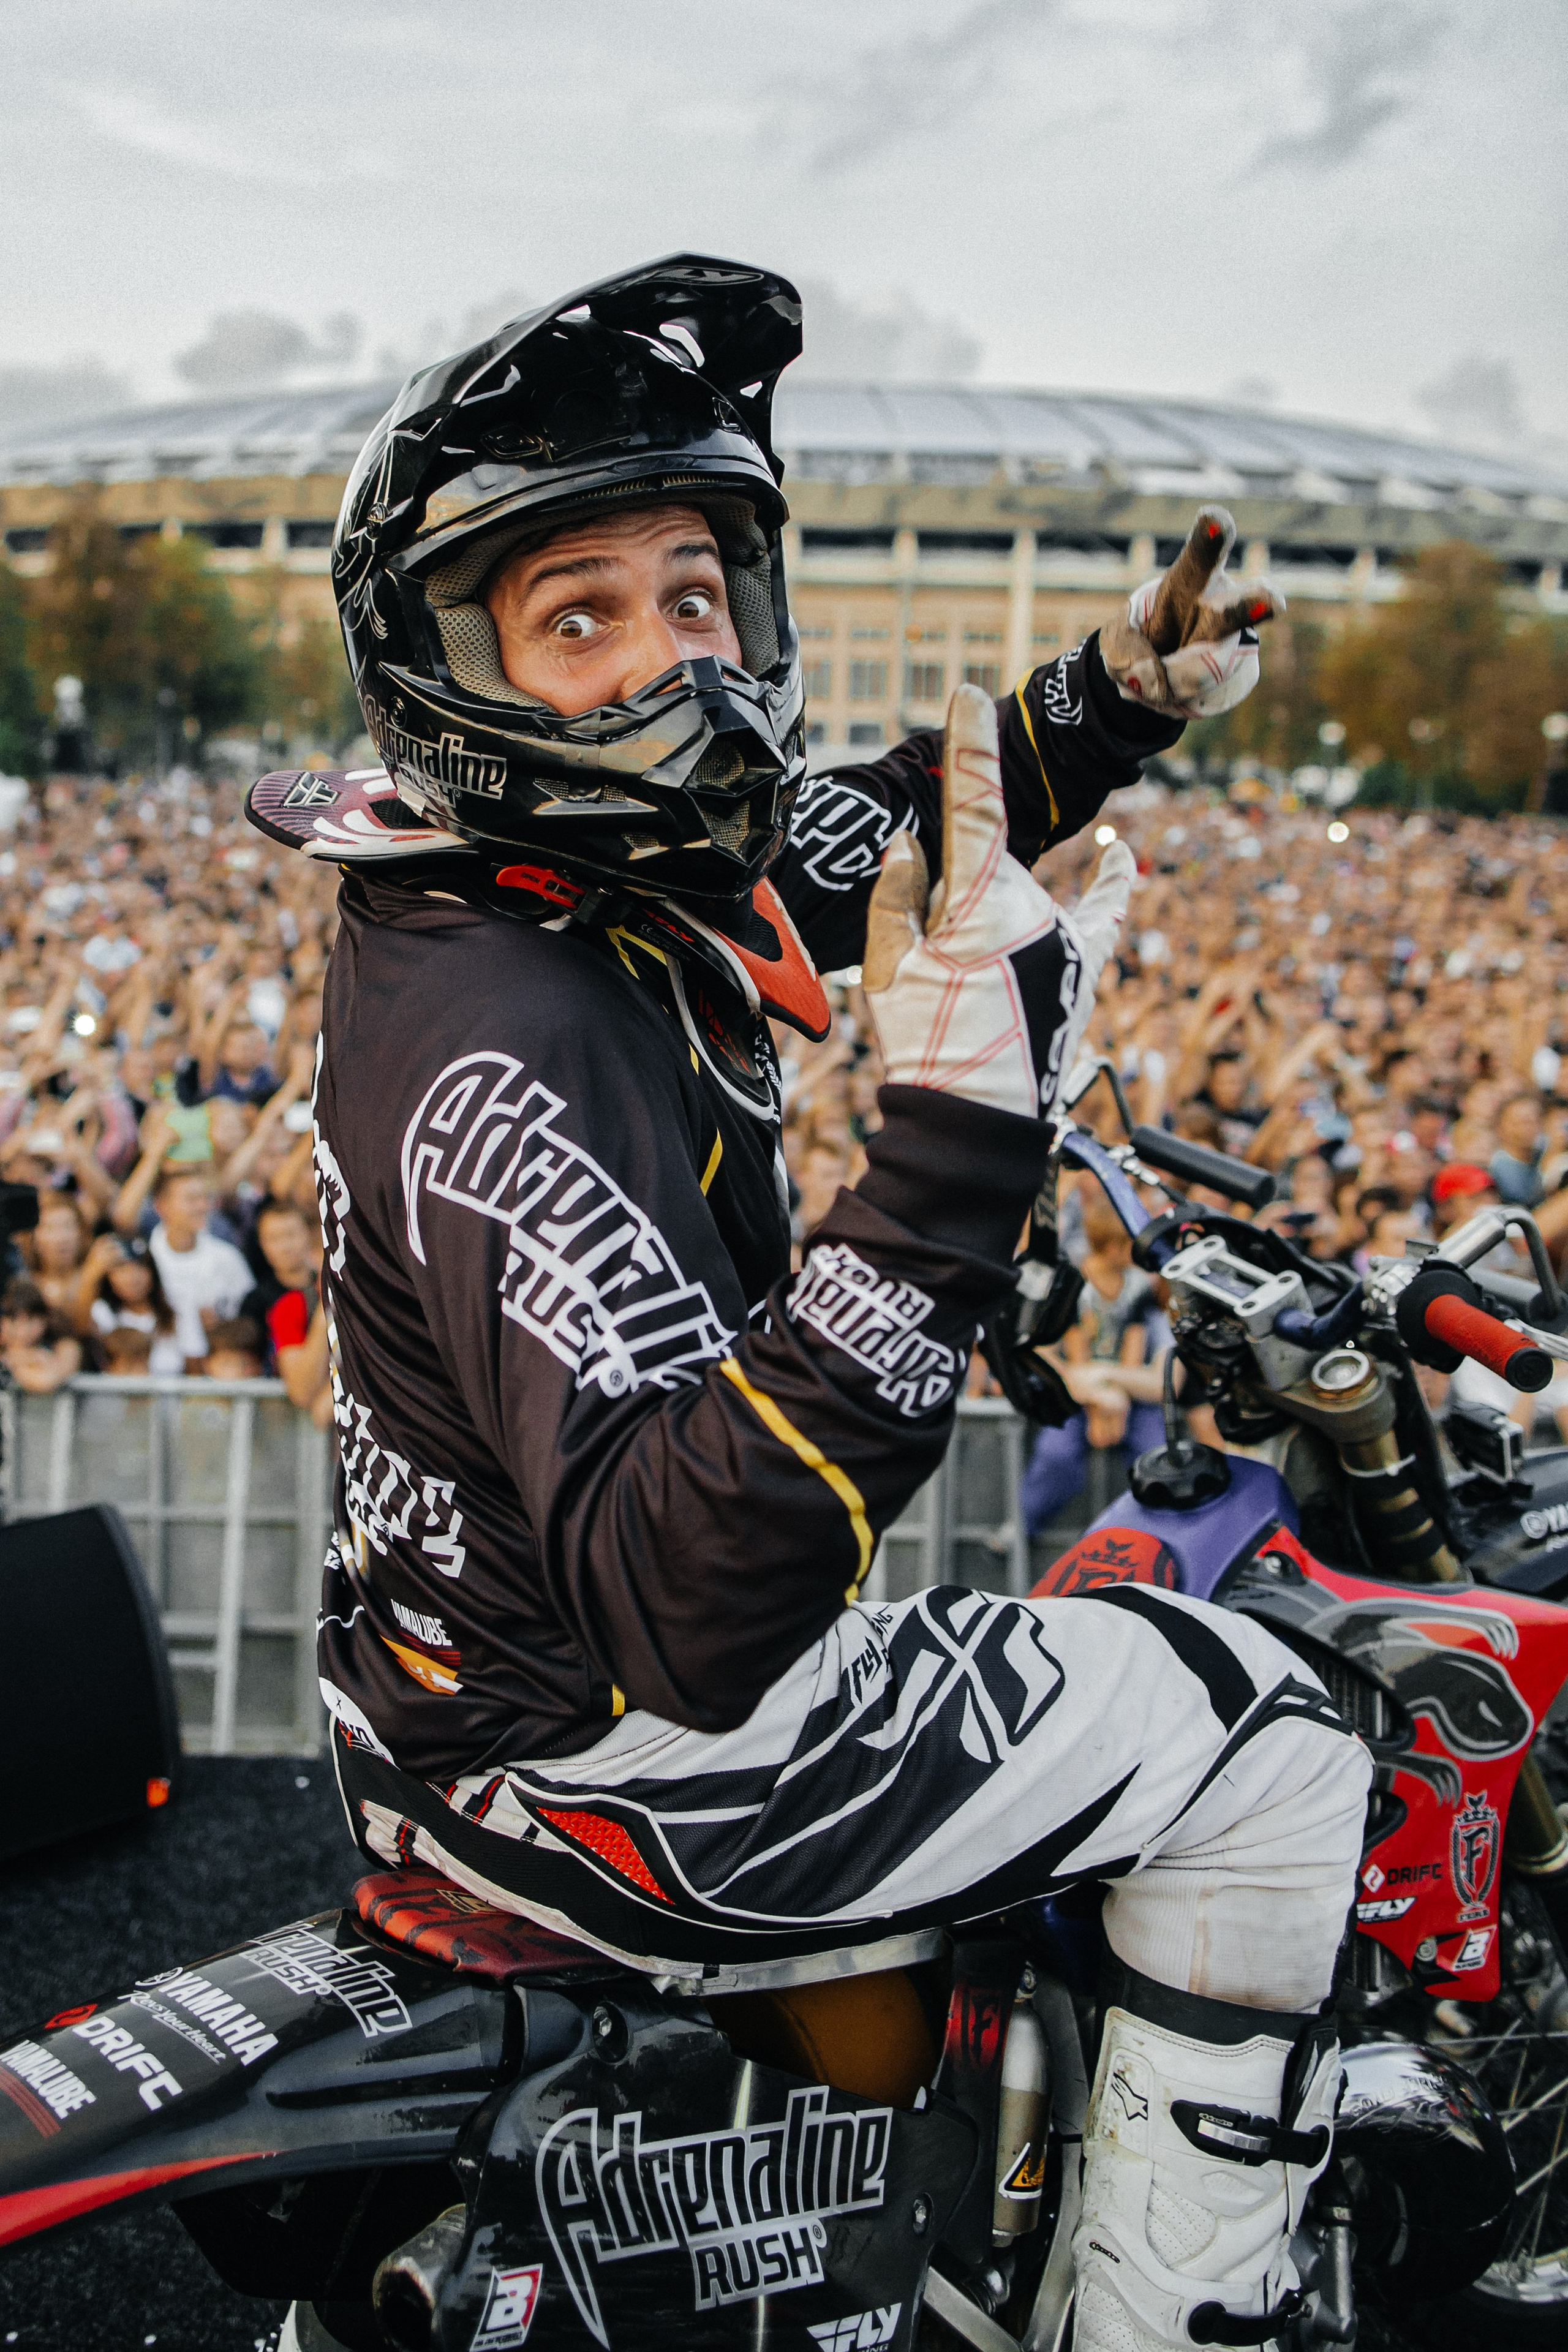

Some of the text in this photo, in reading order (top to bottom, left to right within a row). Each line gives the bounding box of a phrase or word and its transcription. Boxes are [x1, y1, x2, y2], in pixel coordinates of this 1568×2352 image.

[363, 693, 507, 801] Adrenaline
[390, 1599, 452, 1647] YAMALUBE
[1387, 1863, 1442, 1885] DRIFC
[117, 1990, 227, 2060] Revs Your Heart
[158, 1971, 279, 2066] YAMAHA
[72, 2016, 183, 2111] DRIFC
[535, 2085, 893, 2351] Adrenaline
[806, 2302, 902, 2352] FLY
